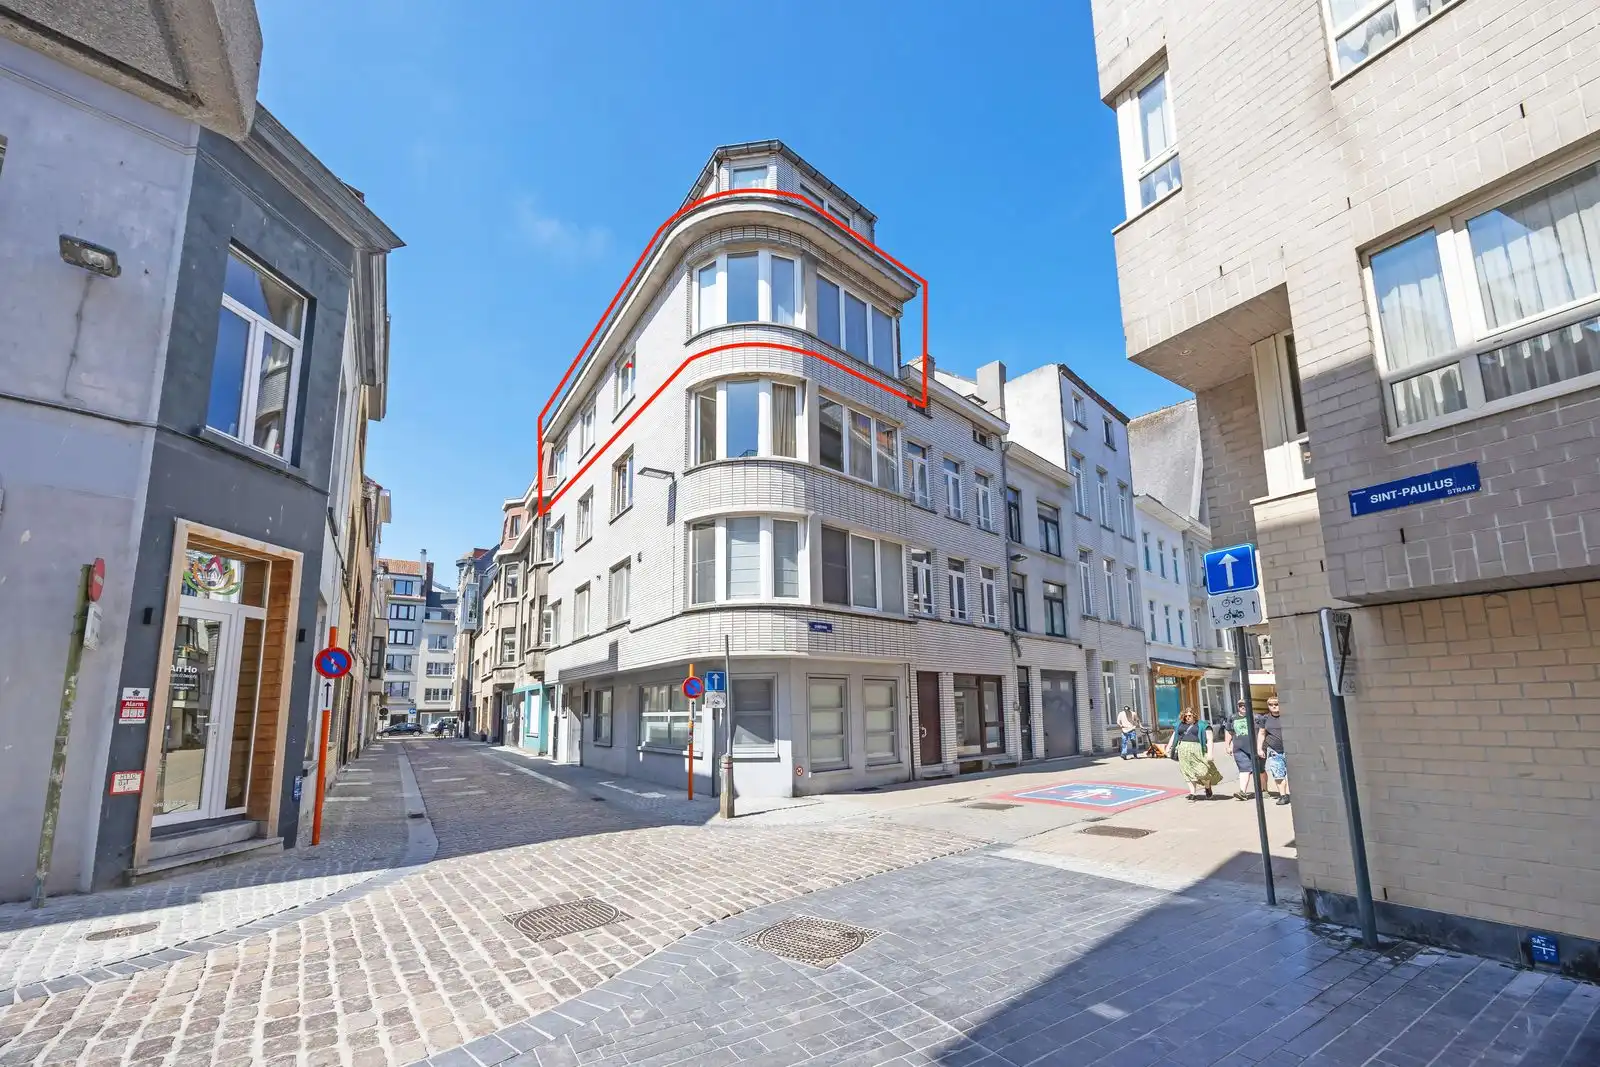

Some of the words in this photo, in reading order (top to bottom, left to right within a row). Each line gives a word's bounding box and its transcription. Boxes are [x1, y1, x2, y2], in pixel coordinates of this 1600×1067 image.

[1370, 478, 1453, 504] SINT-PAULUS
[1447, 484, 1477, 495] STRAAT
[183, 665, 198, 674] Ho
